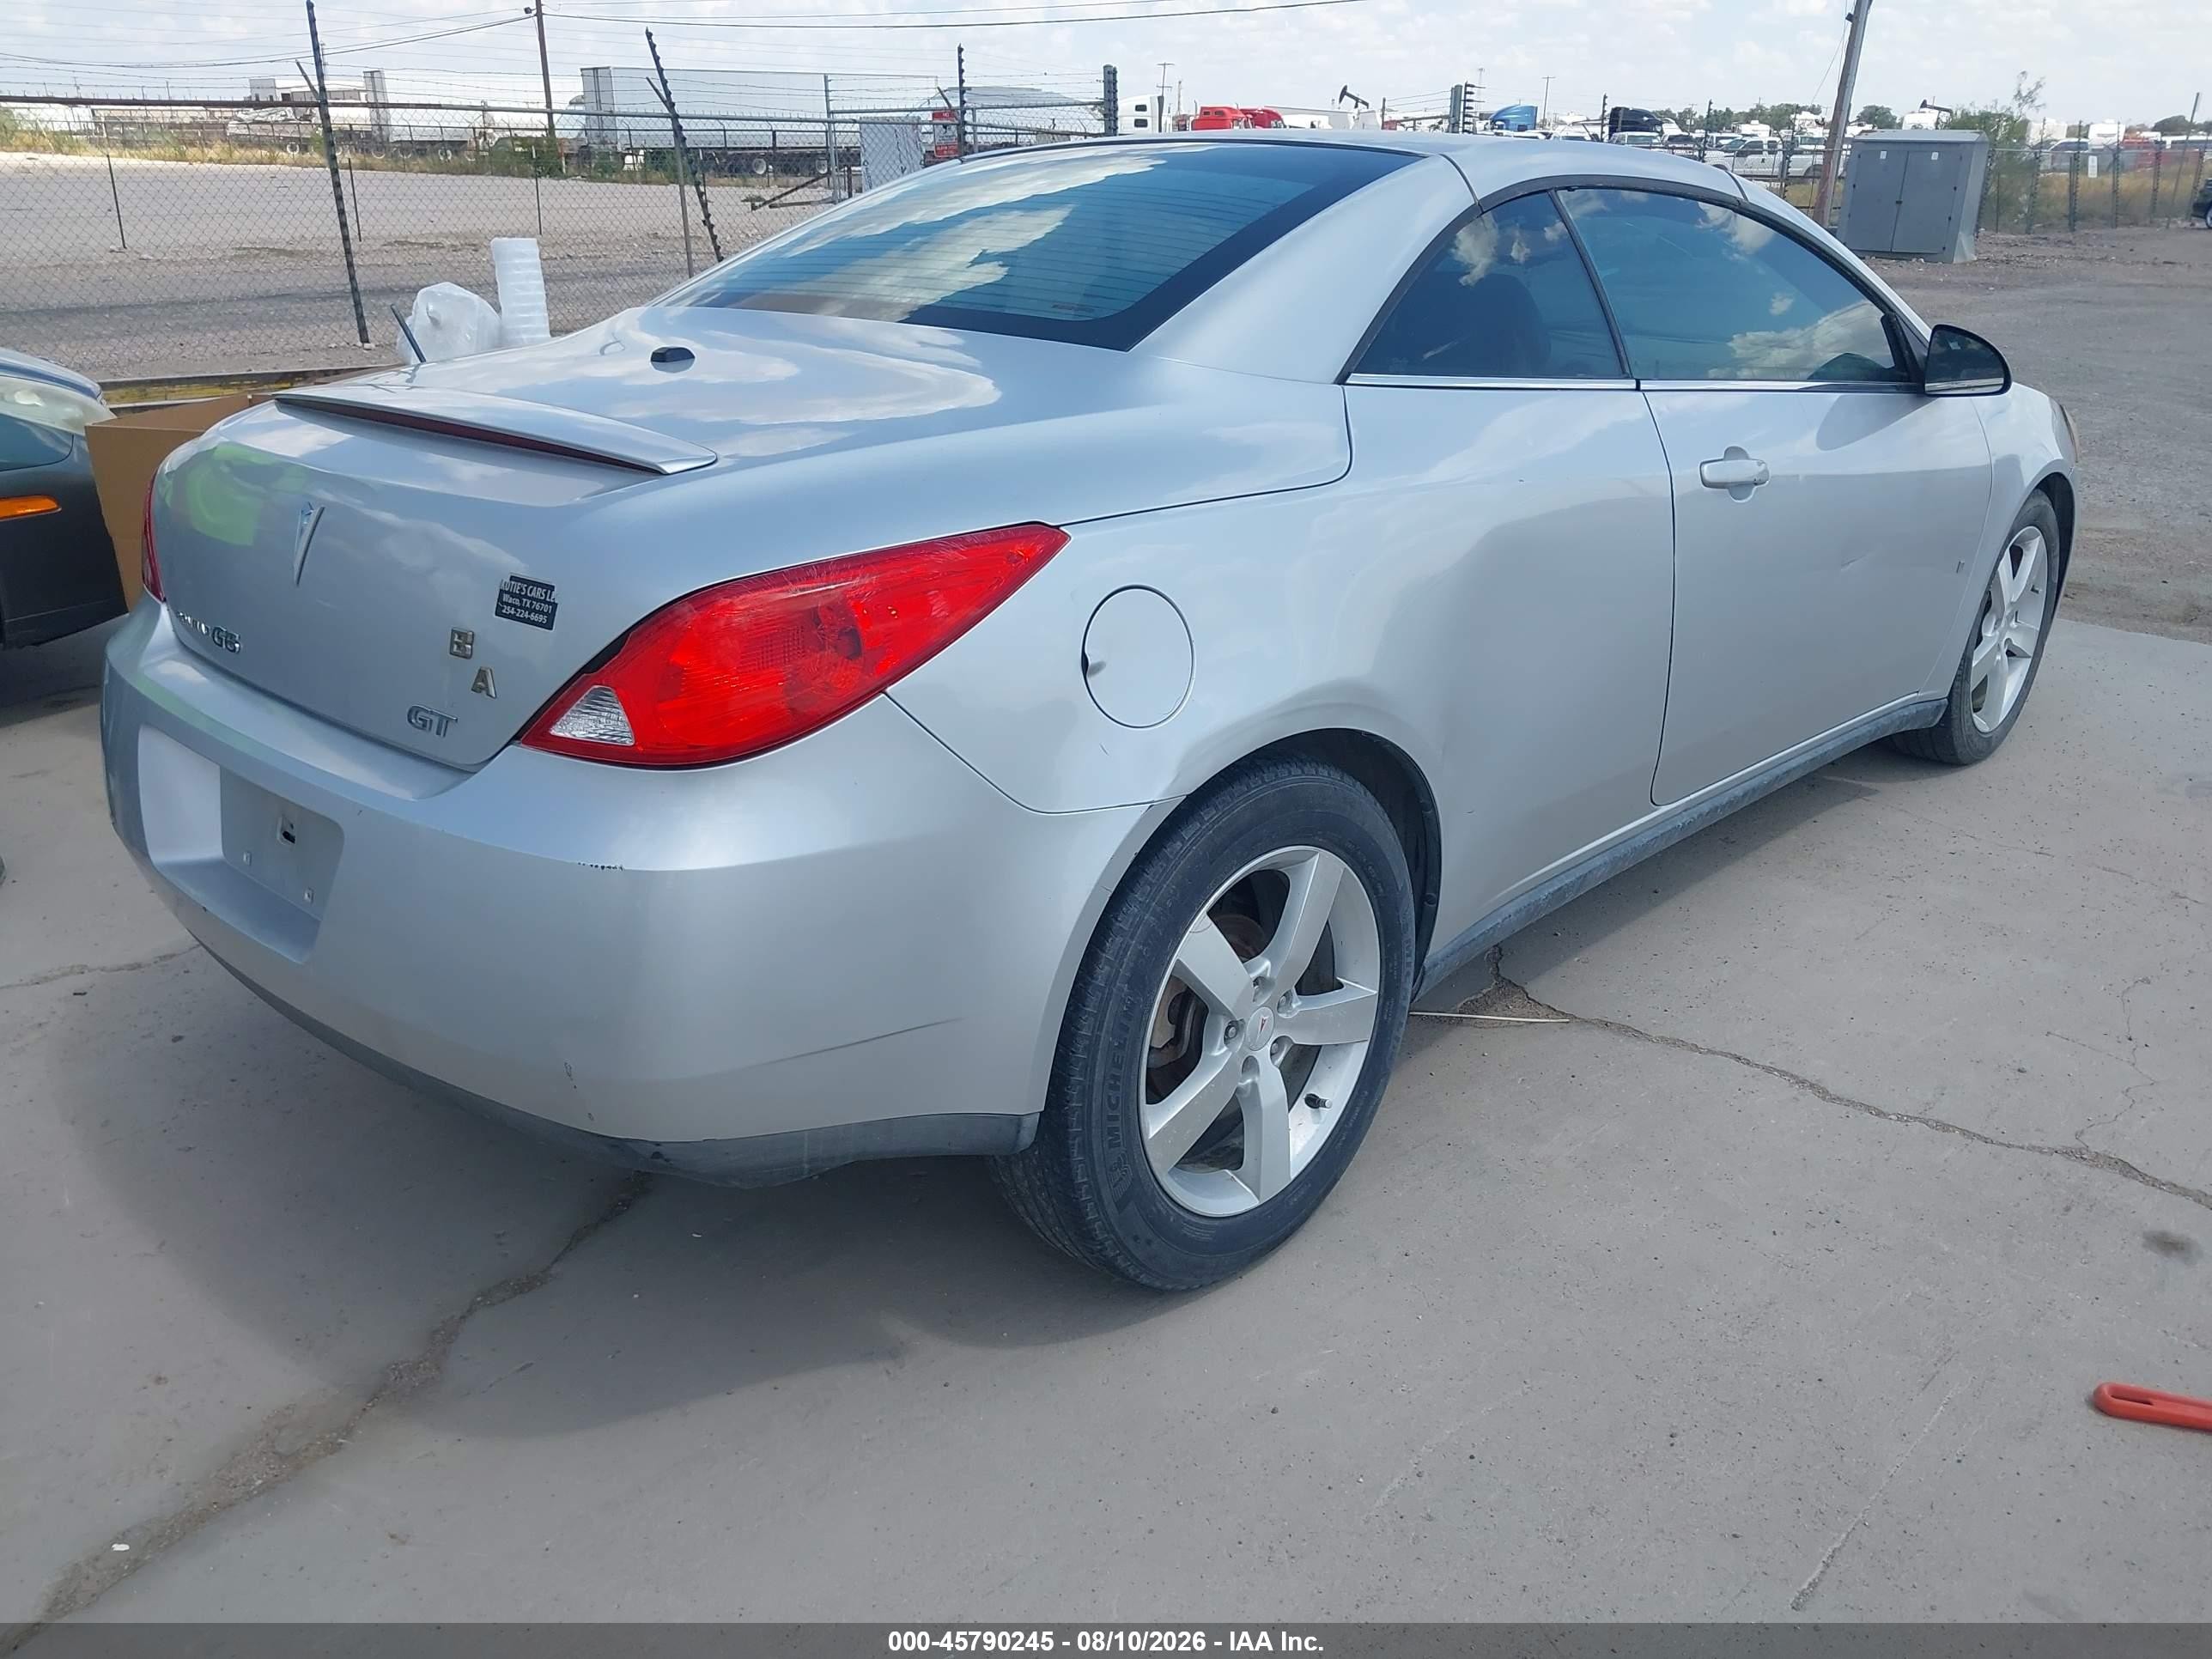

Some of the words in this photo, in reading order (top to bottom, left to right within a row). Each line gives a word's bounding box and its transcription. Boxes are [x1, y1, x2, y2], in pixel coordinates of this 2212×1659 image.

[503, 593, 520, 606] Waco,
[522, 599, 532, 609] TX
[532, 601, 552, 613] 76701
[527, 586, 547, 599] CARS
[471, 666, 497, 699] A
[407, 704, 458, 738] GT
